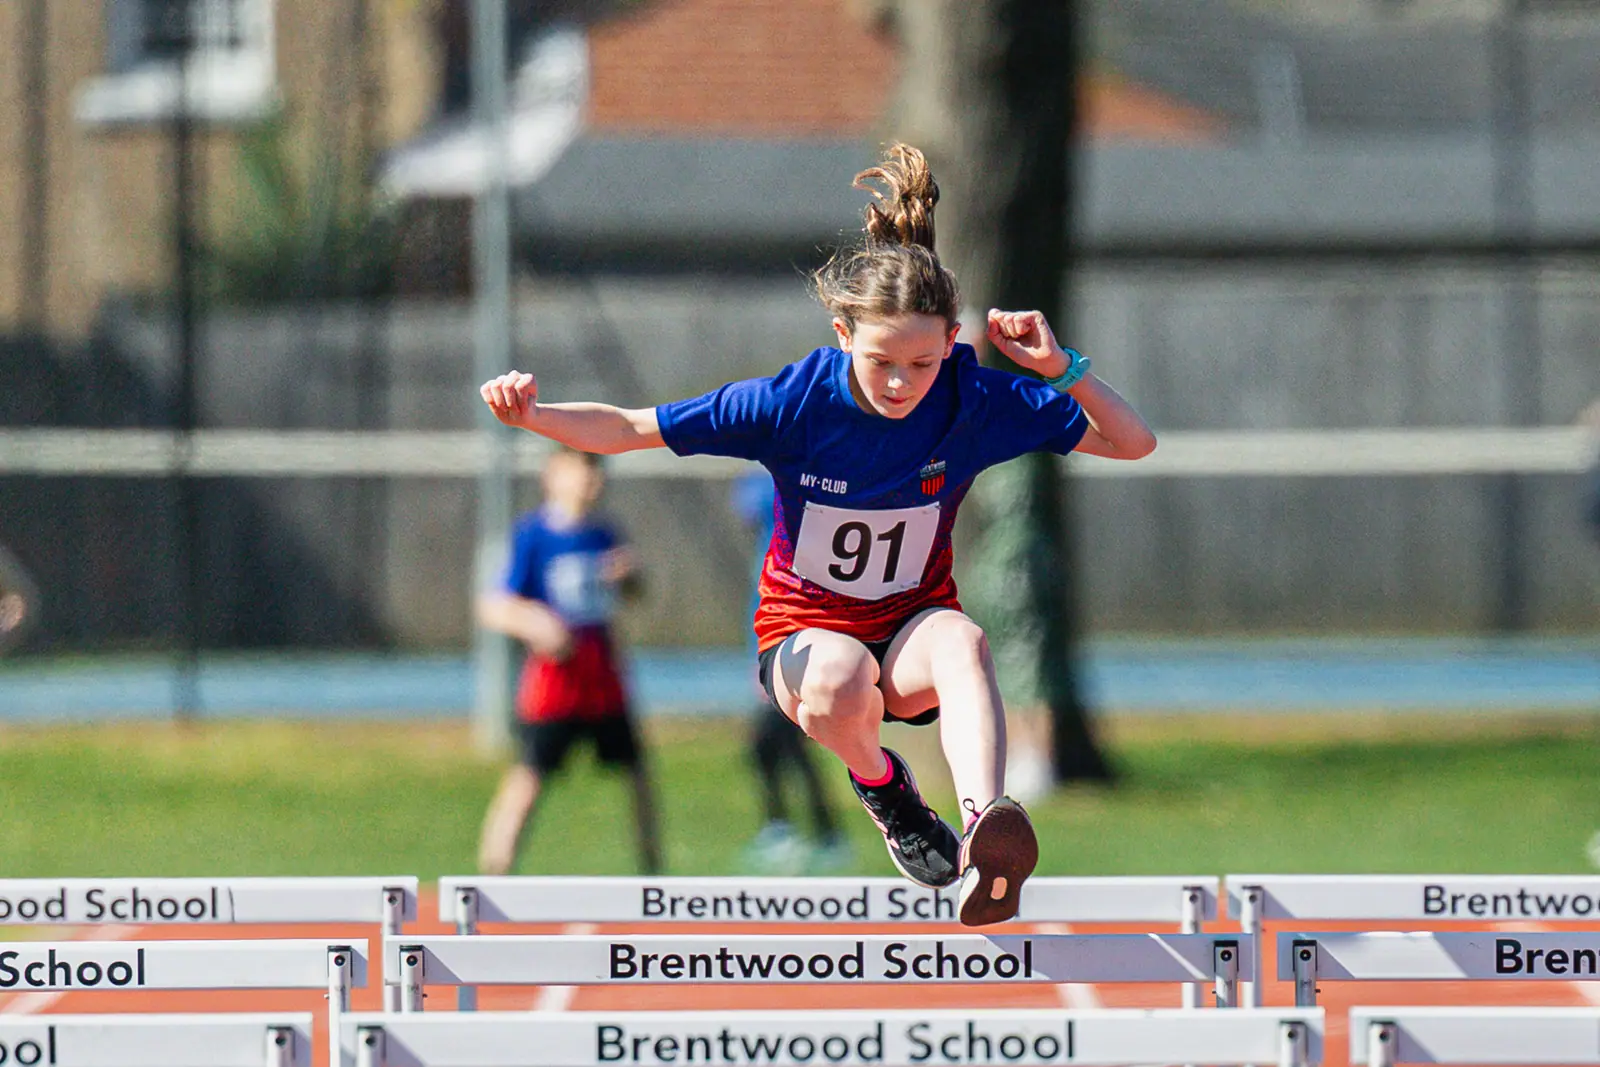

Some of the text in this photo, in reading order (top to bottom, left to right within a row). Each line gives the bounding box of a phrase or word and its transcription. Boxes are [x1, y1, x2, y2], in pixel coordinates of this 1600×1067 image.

[828, 521, 907, 583] 91
[86, 887, 218, 920] School
[643, 886, 956, 919] Brentwood Sch
[1424, 885, 1600, 916] Brentwo
[0, 948, 145, 987] School
[610, 940, 1033, 979] Brentwood School
[1496, 938, 1600, 974] Bren
[597, 1021, 1074, 1063] Brentwood School
